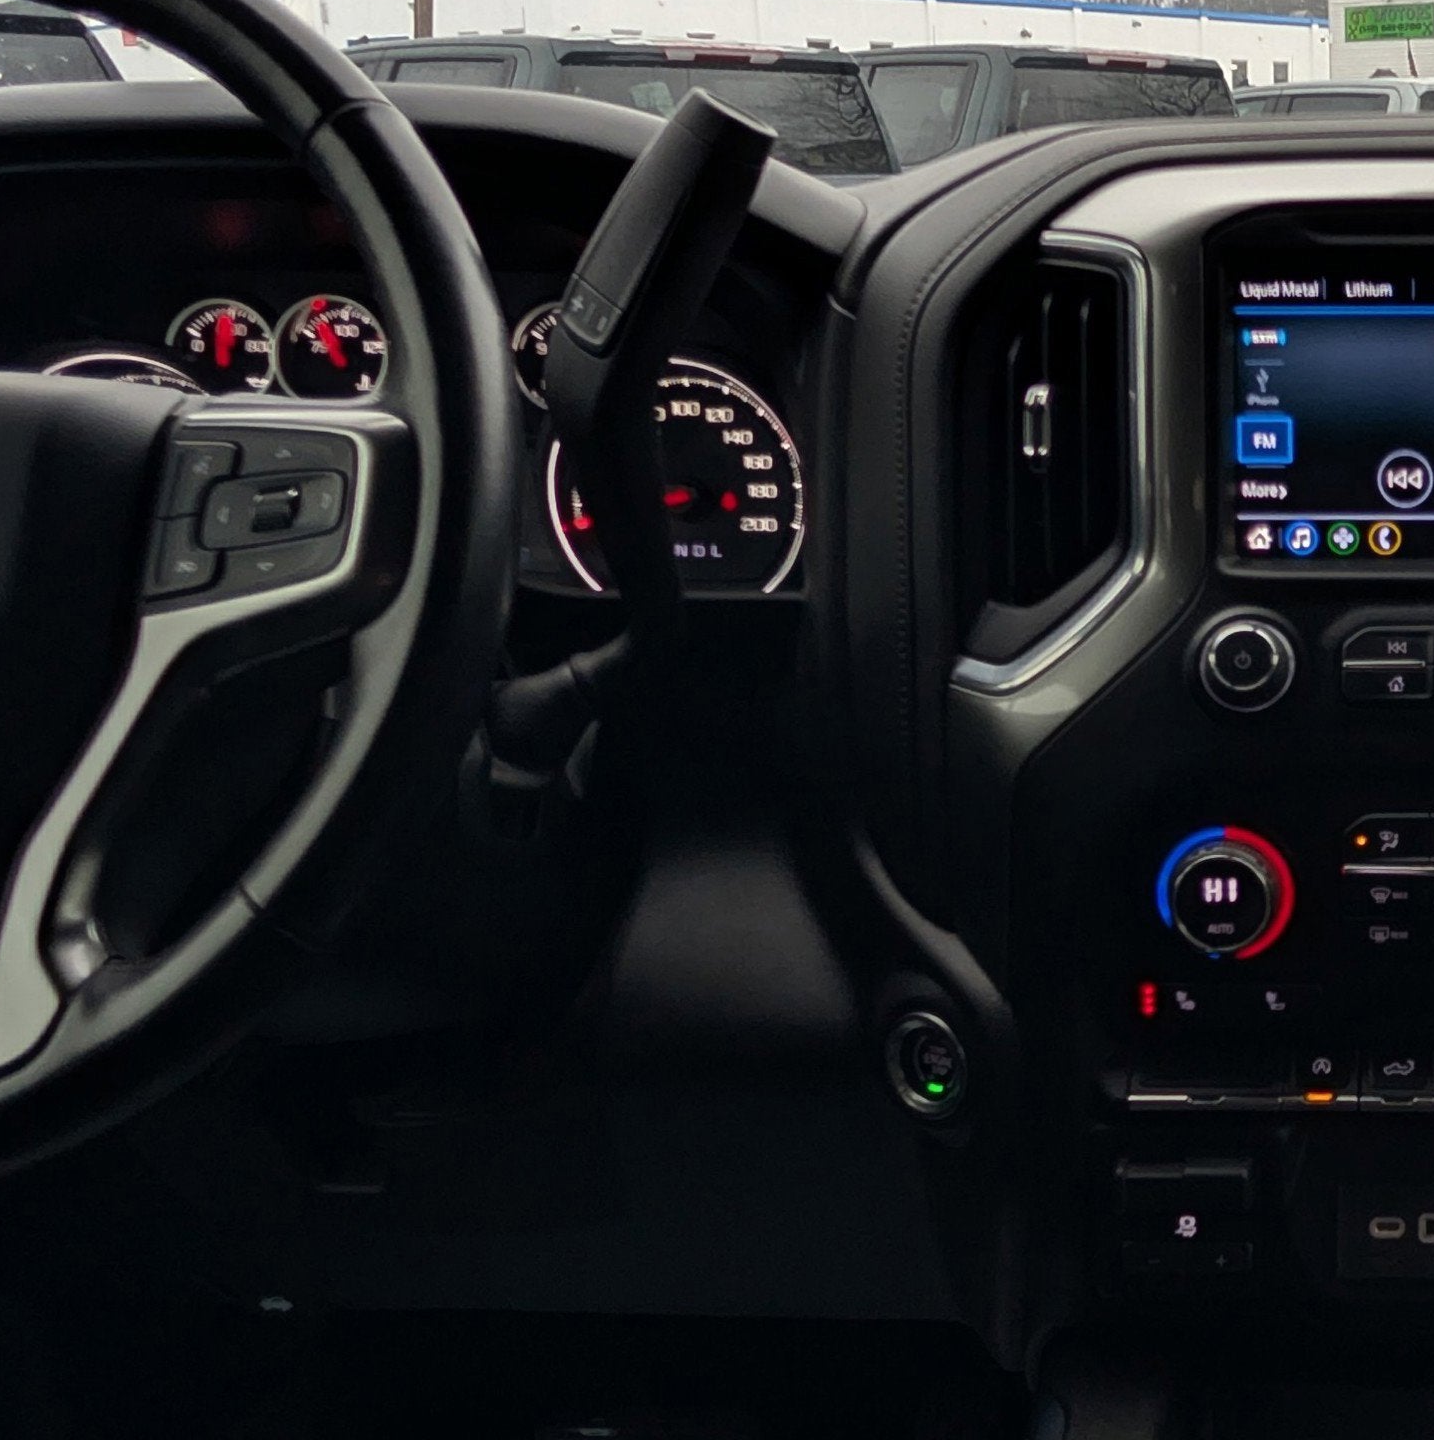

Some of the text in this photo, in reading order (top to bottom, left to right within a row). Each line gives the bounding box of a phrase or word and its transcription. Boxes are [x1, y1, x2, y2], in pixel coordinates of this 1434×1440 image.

[1239, 280, 1319, 301] Liquid Metal
[1344, 280, 1394, 298] Lithium
[670, 400, 702, 417] 100
[704, 407, 734, 423] 120
[722, 429, 754, 446] 140
[1253, 432, 1276, 450] FM
[742, 453, 773, 470] 160
[739, 516, 779, 533] 200
[710, 544, 724, 559] L
[1201, 877, 1239, 903] HI
[1206, 922, 1235, 936] AUTO
